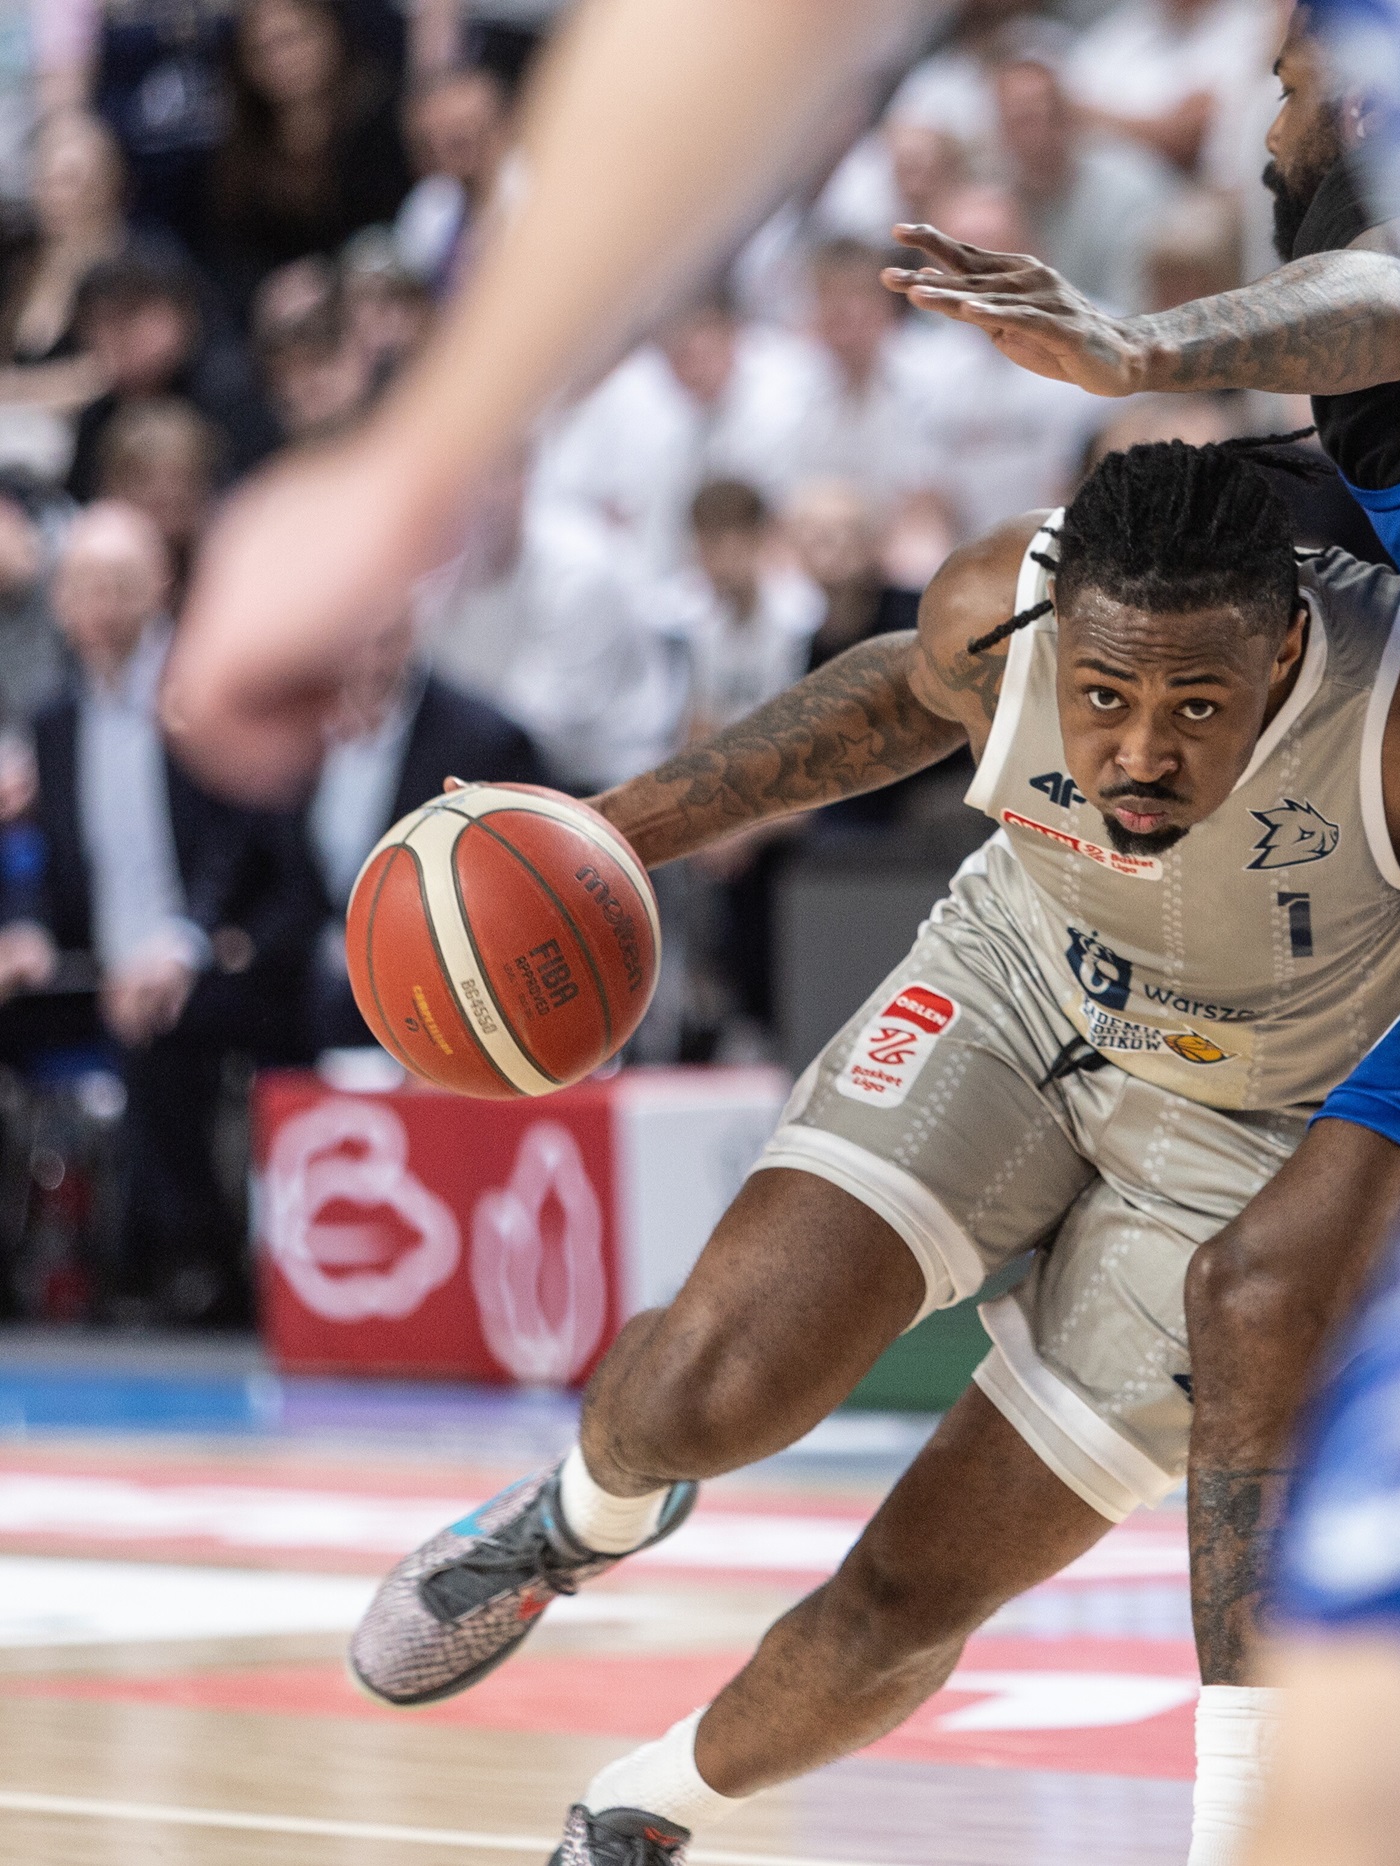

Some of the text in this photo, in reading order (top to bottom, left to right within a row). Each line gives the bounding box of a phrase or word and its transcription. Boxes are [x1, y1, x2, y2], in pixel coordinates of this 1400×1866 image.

[574, 865, 643, 993] molten
[1277, 891, 1314, 958] 1
[514, 956, 551, 1017] APPROVED
[530, 938, 580, 1010] FIBA
[895, 995, 948, 1027] ORLEN
[851, 1064, 903, 1087] Basket
[852, 1076, 886, 1093] Liga
